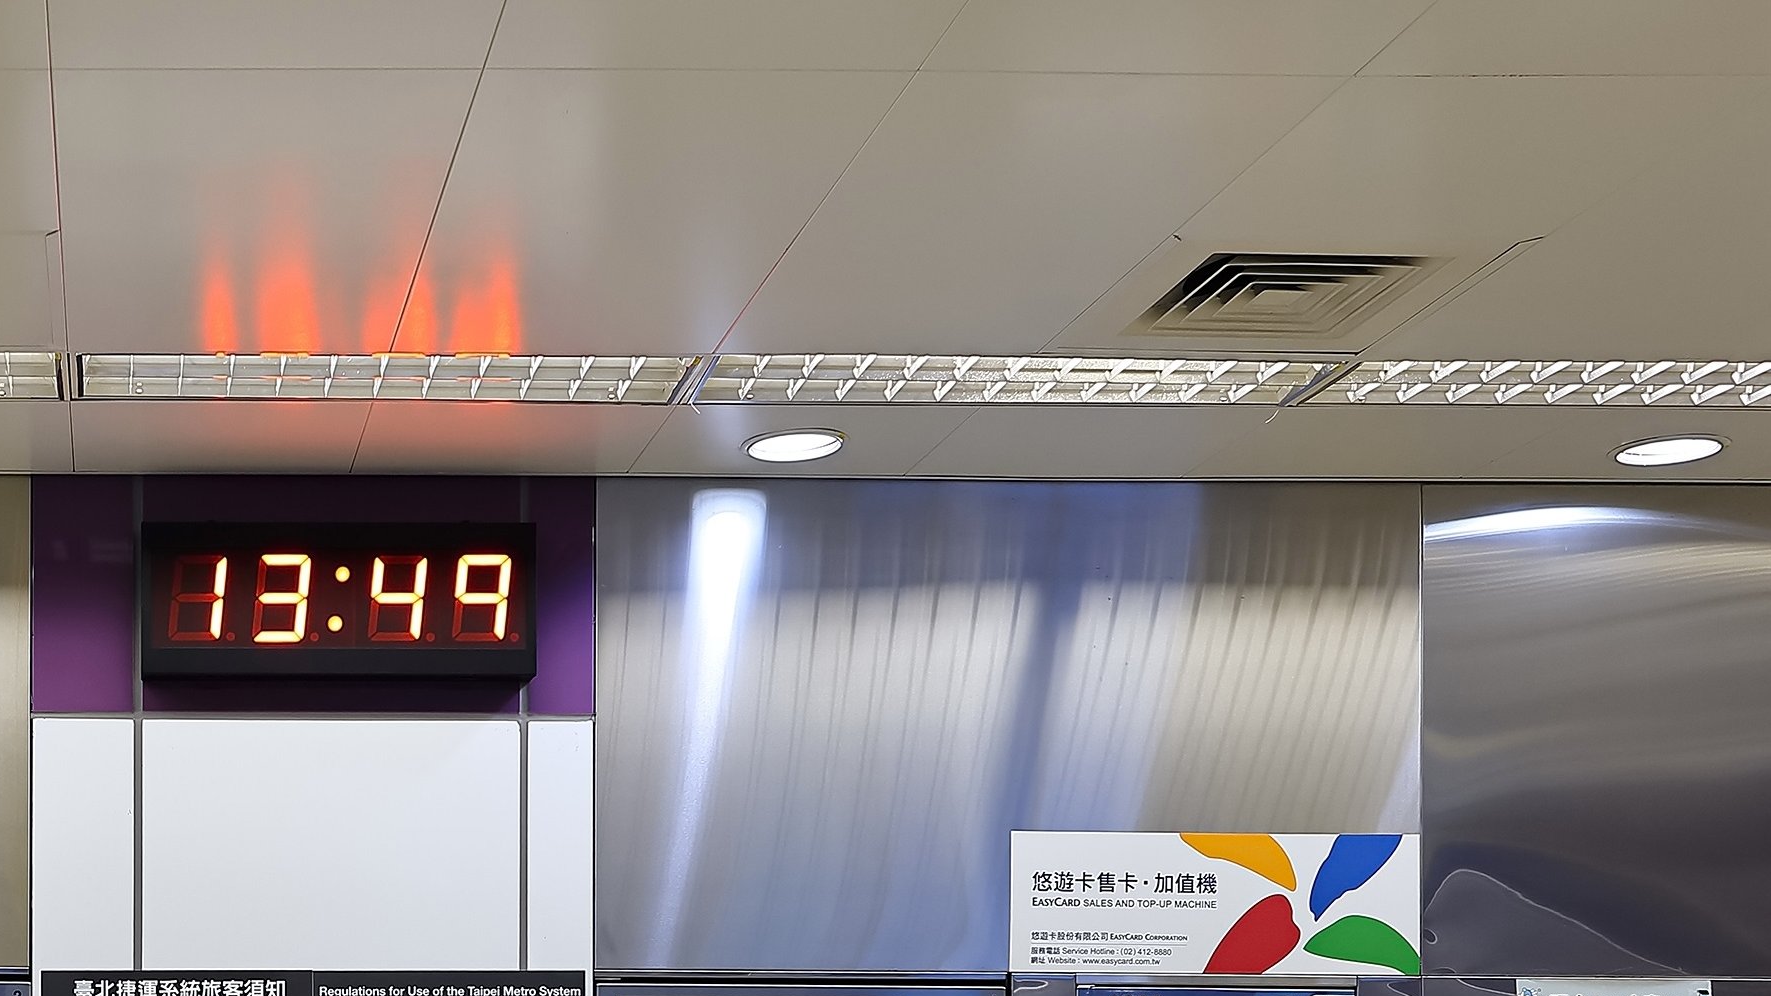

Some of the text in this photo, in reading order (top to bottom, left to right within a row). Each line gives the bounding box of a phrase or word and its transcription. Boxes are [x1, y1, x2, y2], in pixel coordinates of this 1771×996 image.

[210, 554, 511, 643] 13:49
[1083, 899, 1113, 907] SALES
[1137, 900, 1171, 908] TOP-UP
[1031, 932, 1108, 941] 悠遊卡股份有限公司
[1082, 958, 1160, 966] www.easycard.com.tw
[389, 986, 405, 996] for
[407, 987, 430, 996] Use
[432, 986, 444, 996] of
[447, 986, 464, 996] the
[503, 987, 536, 996] Metro
